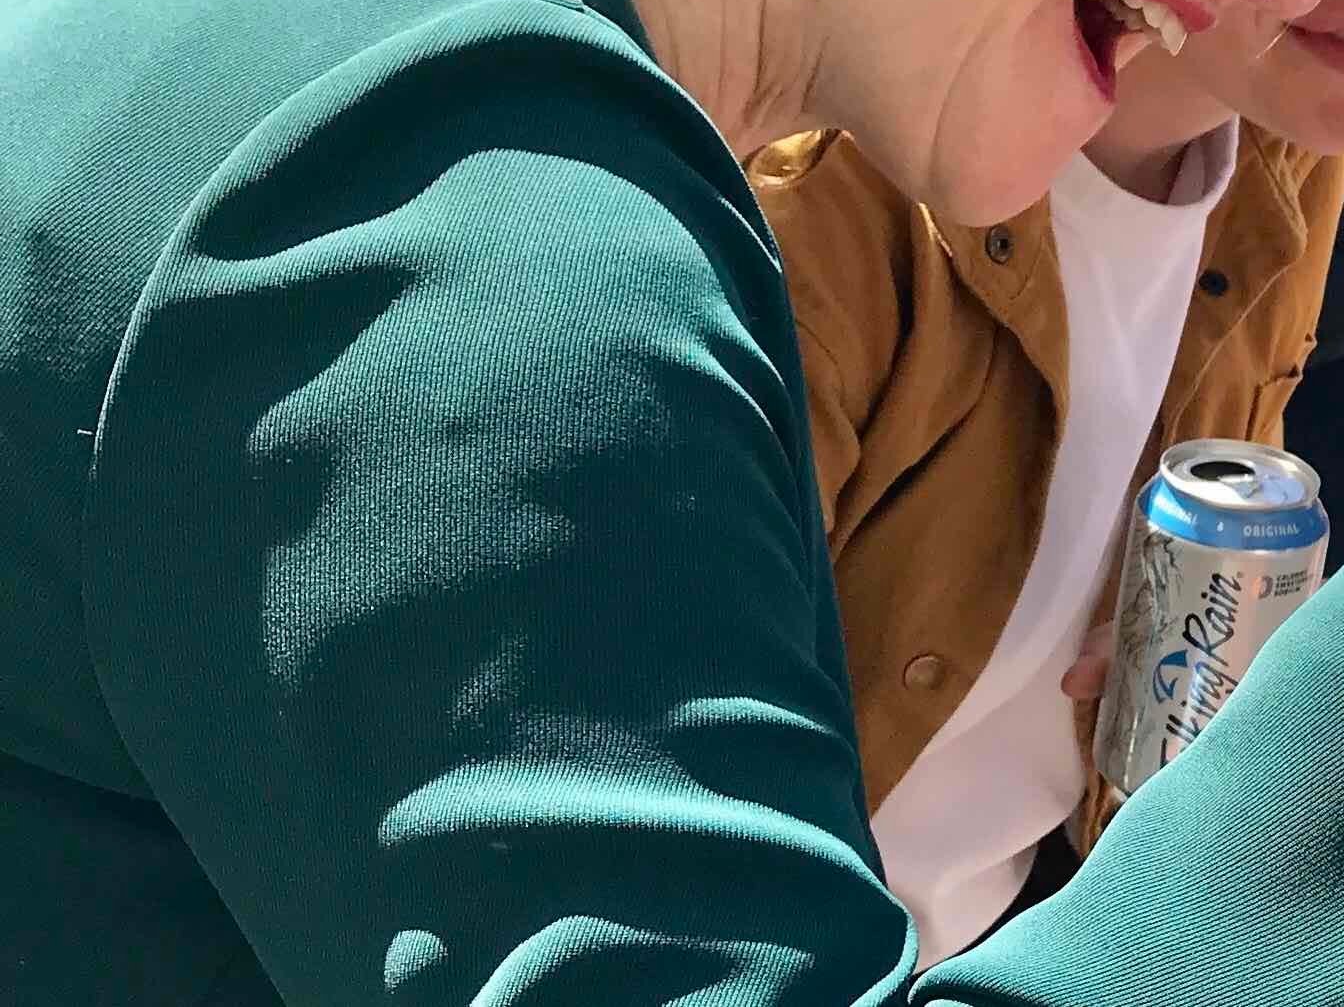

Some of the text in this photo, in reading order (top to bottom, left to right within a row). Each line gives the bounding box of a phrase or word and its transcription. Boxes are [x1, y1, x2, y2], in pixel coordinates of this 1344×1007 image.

[1243, 523, 1300, 537] ORIGINAL
[1160, 572, 1242, 769] lking Rain
